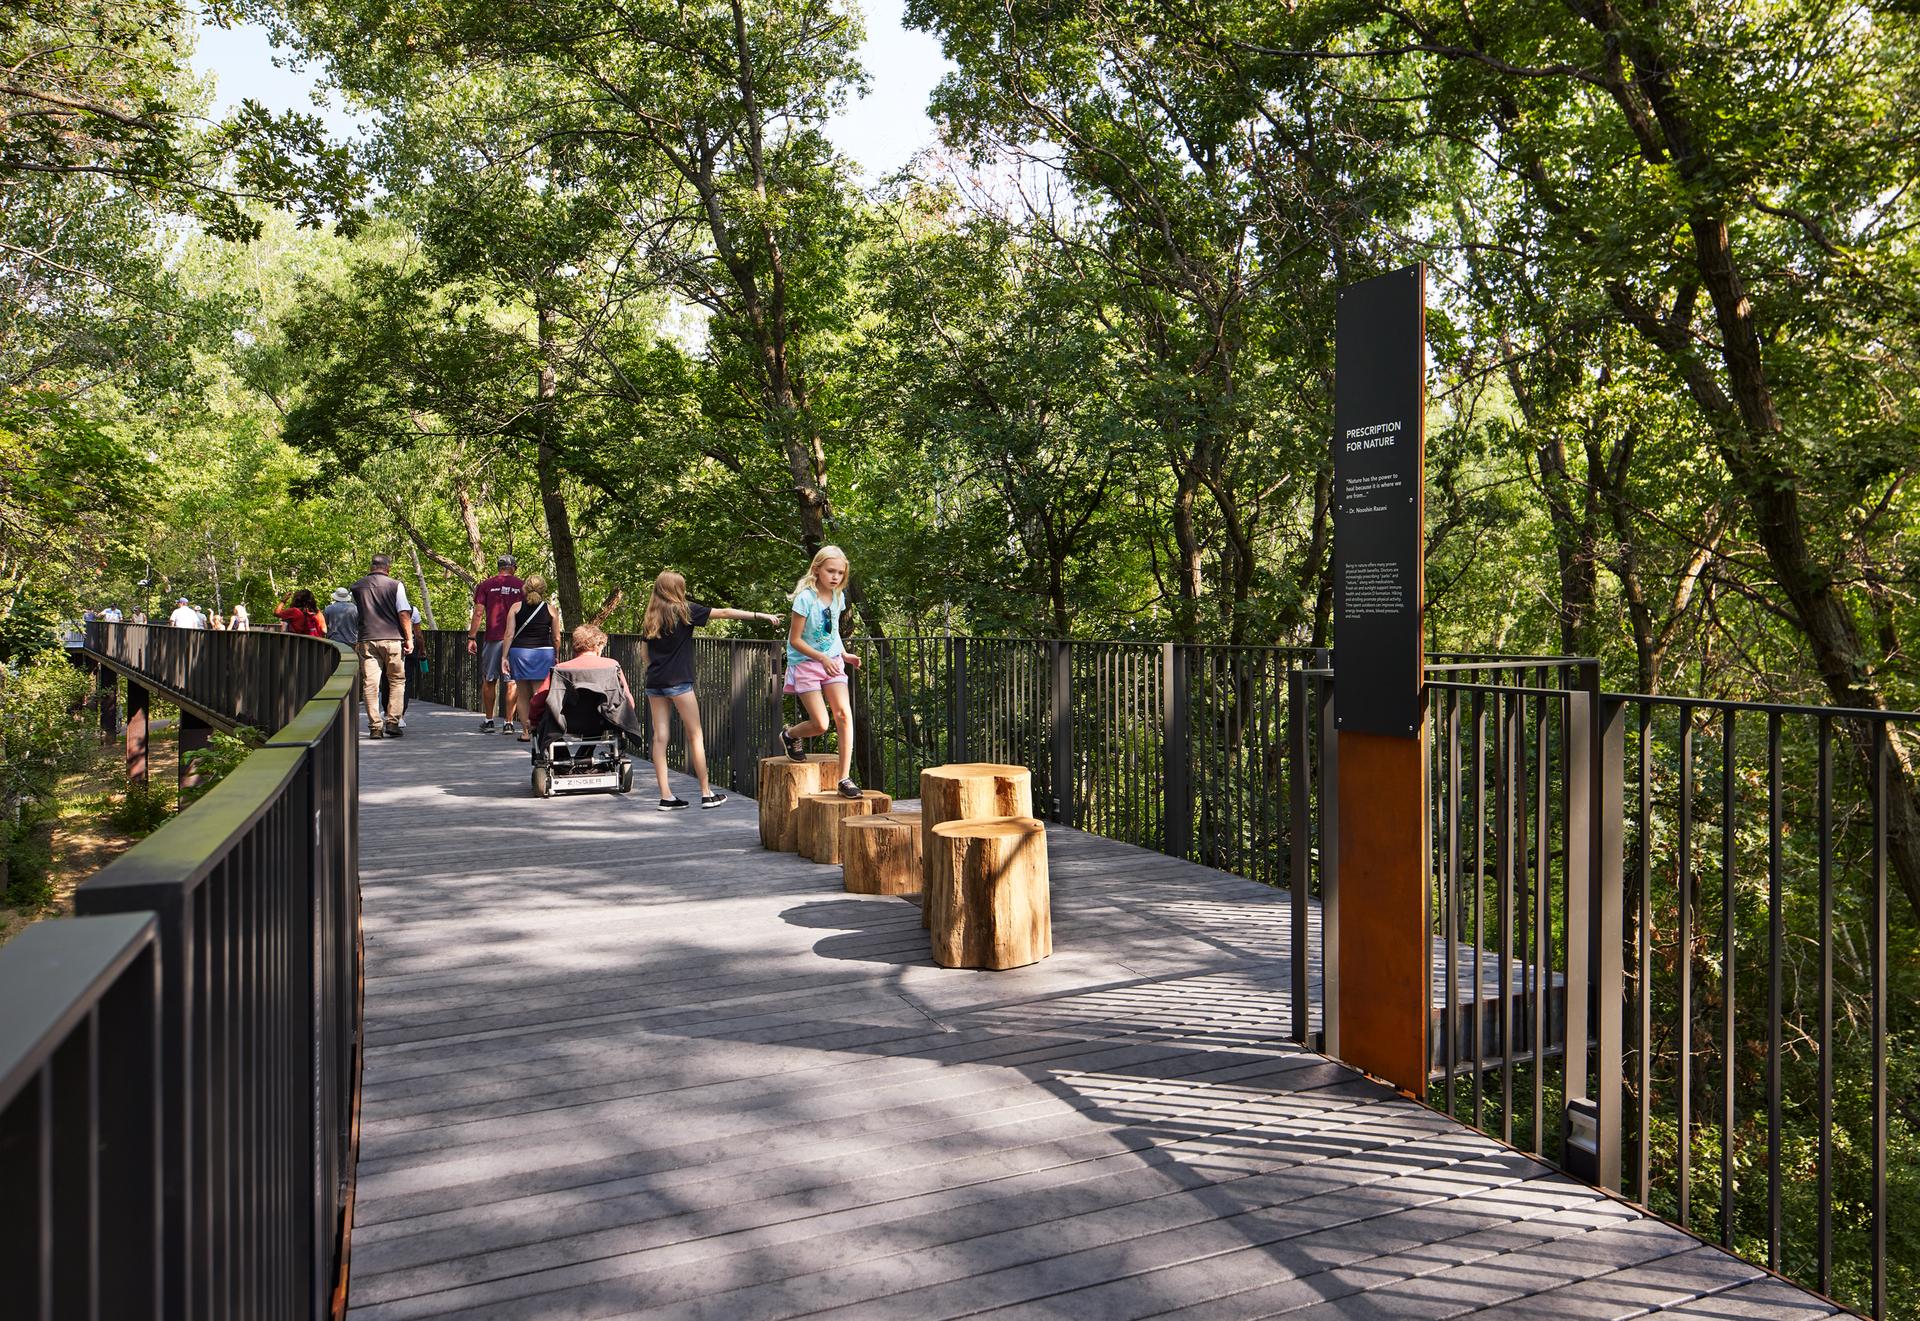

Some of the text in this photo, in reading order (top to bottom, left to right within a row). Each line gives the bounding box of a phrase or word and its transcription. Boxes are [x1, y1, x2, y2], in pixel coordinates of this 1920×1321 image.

[1346, 421, 1401, 438] PRESCRIPTION
[1346, 436, 1395, 451] FOR NATURE
[567, 778, 602, 786] ZINGER
